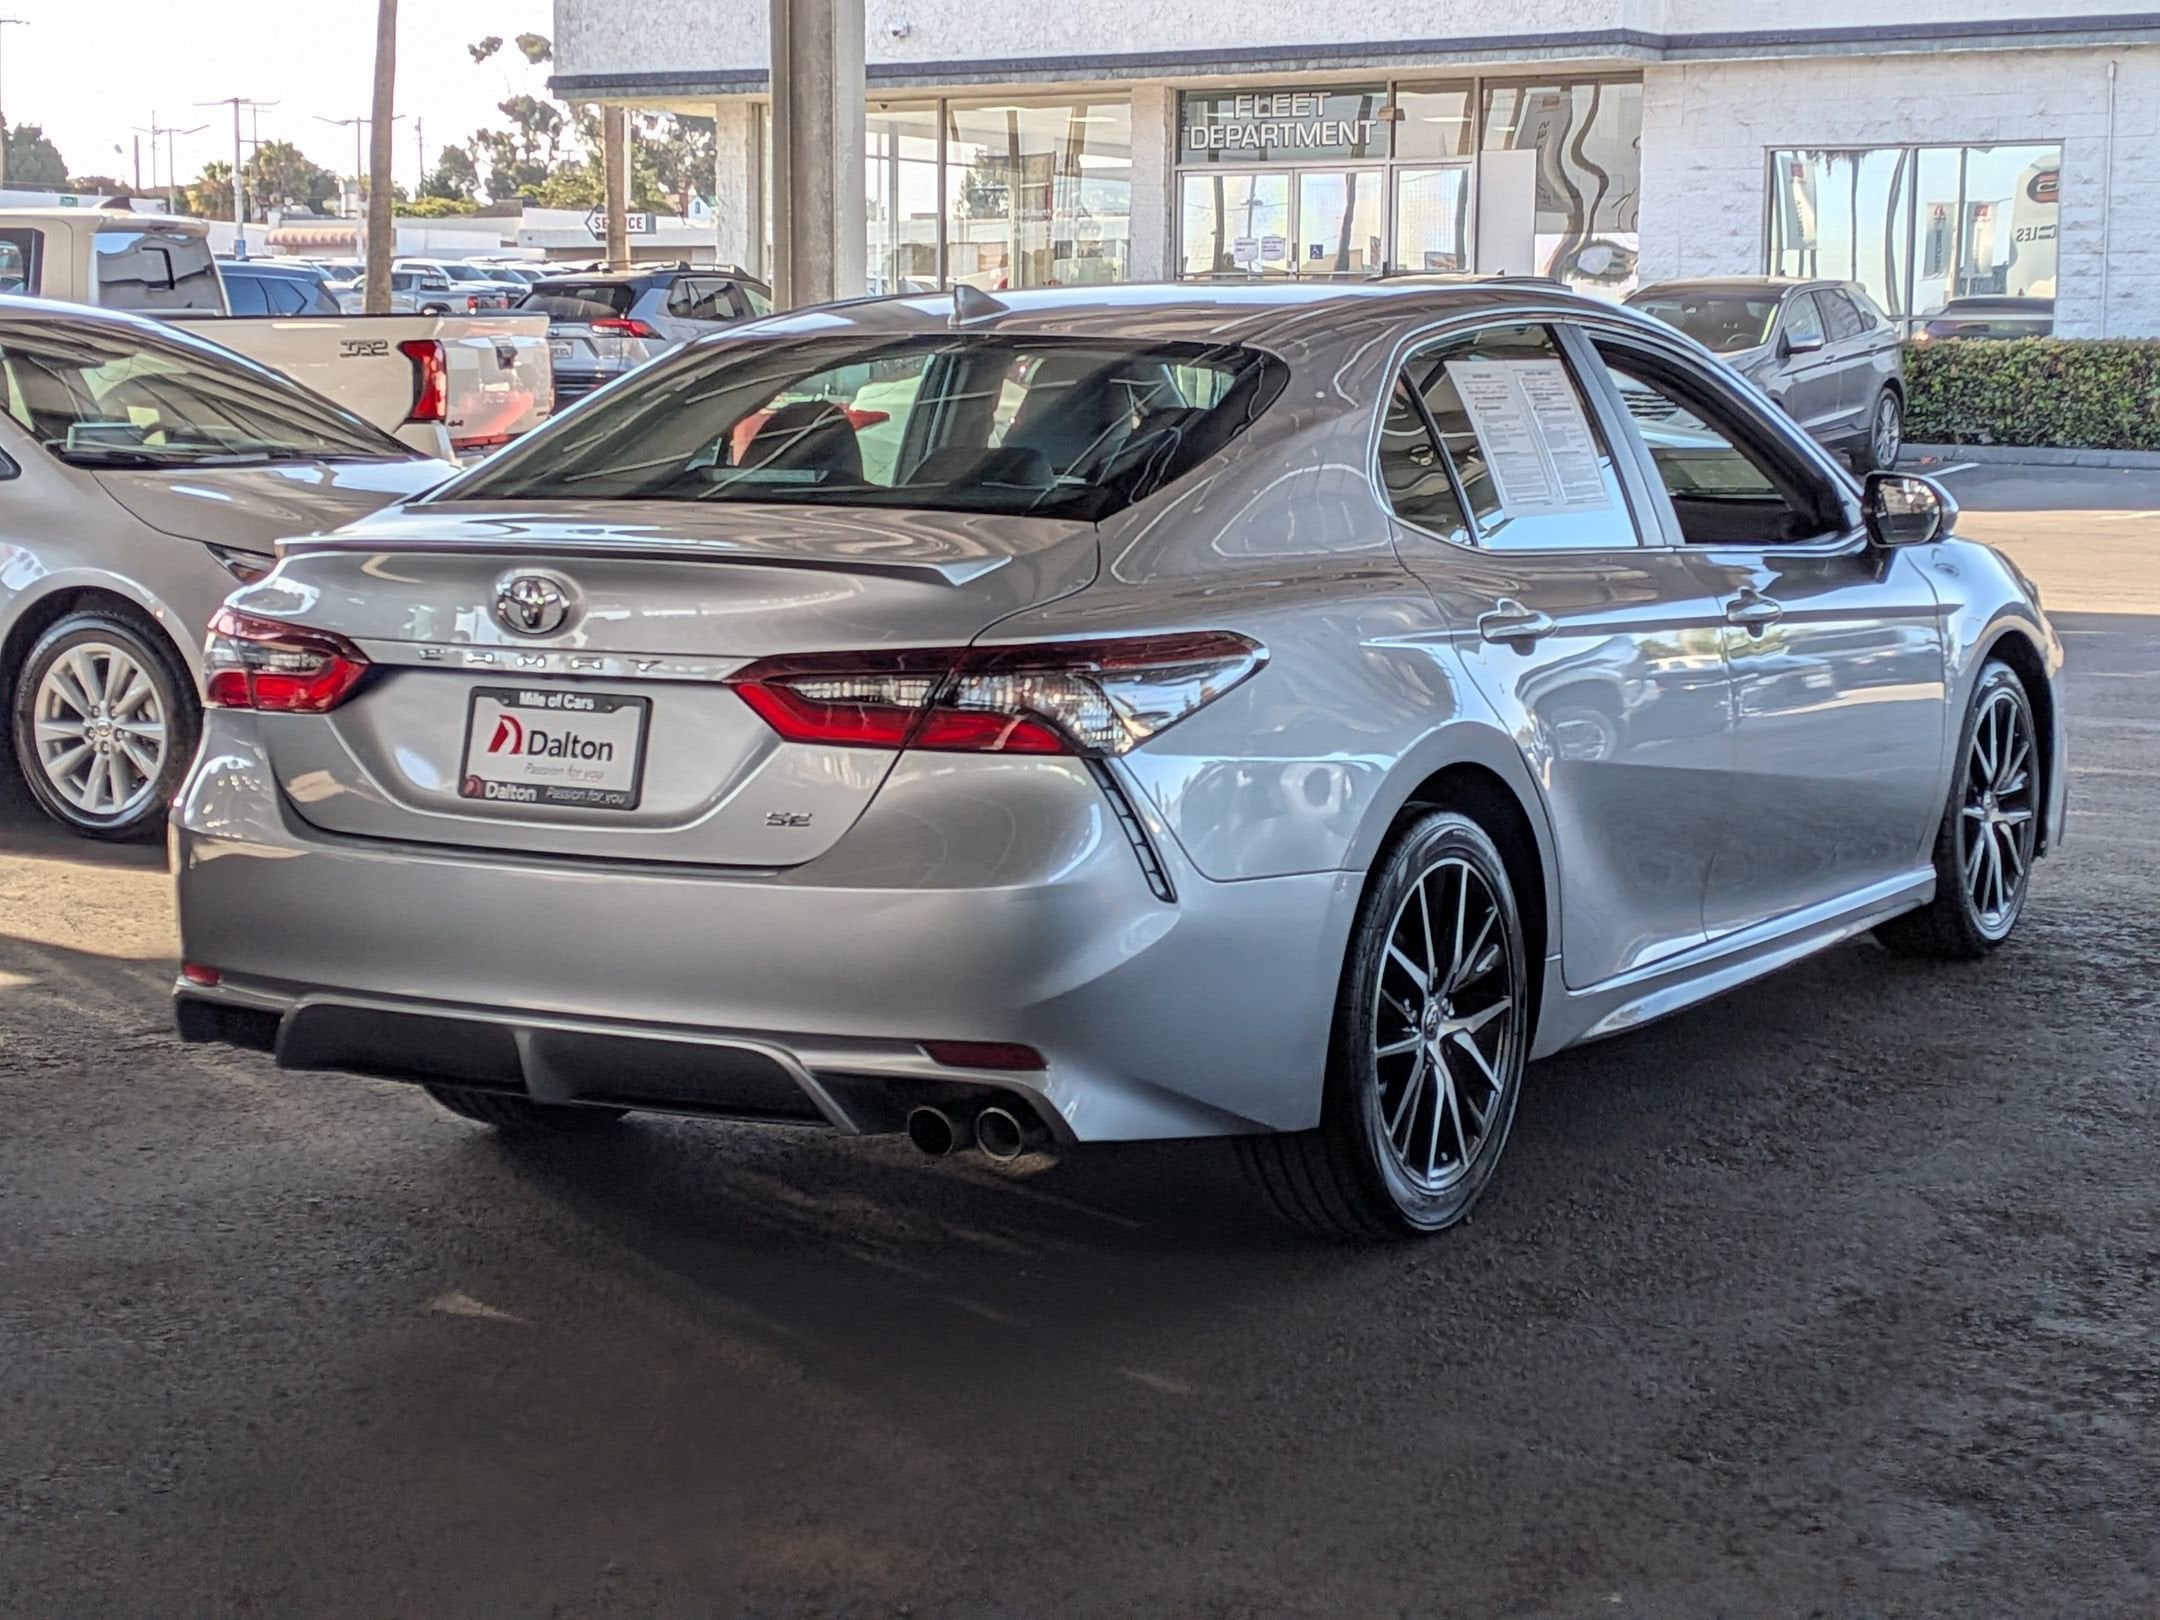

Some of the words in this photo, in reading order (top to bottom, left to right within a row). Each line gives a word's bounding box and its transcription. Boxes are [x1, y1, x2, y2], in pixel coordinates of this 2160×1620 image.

[1233, 92, 1331, 119] FLEET
[1189, 120, 1377, 150] DEPARTMENT
[519, 691, 546, 707] Mile
[547, 693, 563, 708] of
[563, 694, 594, 710] Cars
[526, 730, 613, 762] Dalton
[485, 781, 538, 802] Dalton
[765, 811, 813, 828] SE
